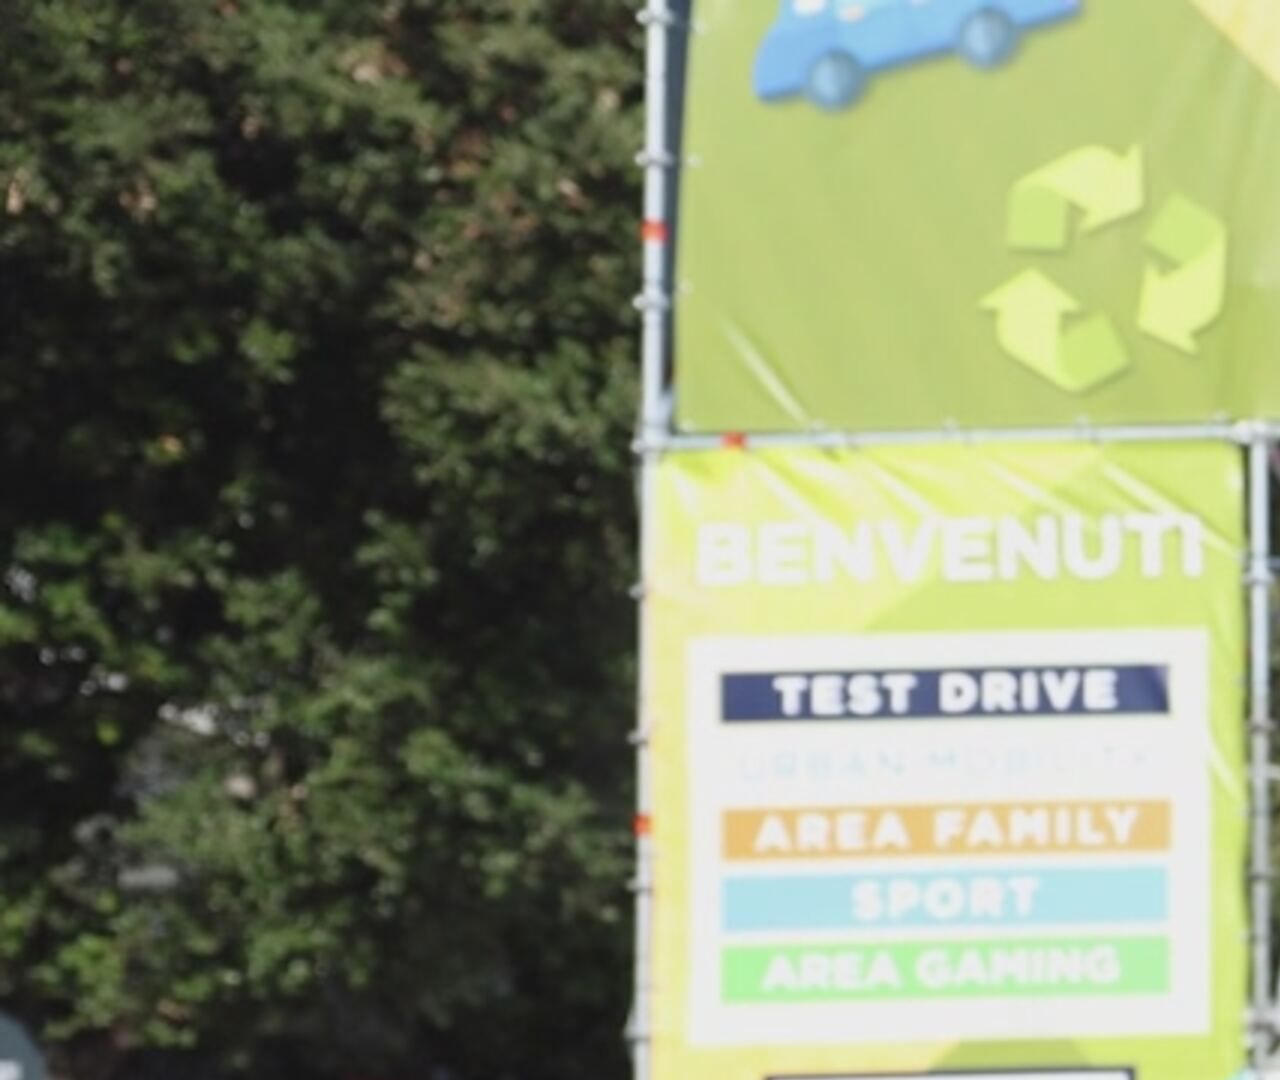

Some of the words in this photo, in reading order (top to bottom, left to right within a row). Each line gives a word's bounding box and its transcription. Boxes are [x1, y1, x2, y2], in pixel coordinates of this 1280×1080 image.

[696, 512, 1206, 586] BENVENUTI
[773, 672, 917, 716] TEST
[938, 669, 1119, 713] DRIVE
[755, 812, 911, 852] AREA
[933, 805, 1139, 846] FAMILY
[850, 875, 1041, 920] SPORT
[762, 949, 905, 993] AREA
[914, 943, 1122, 987] GAMING
